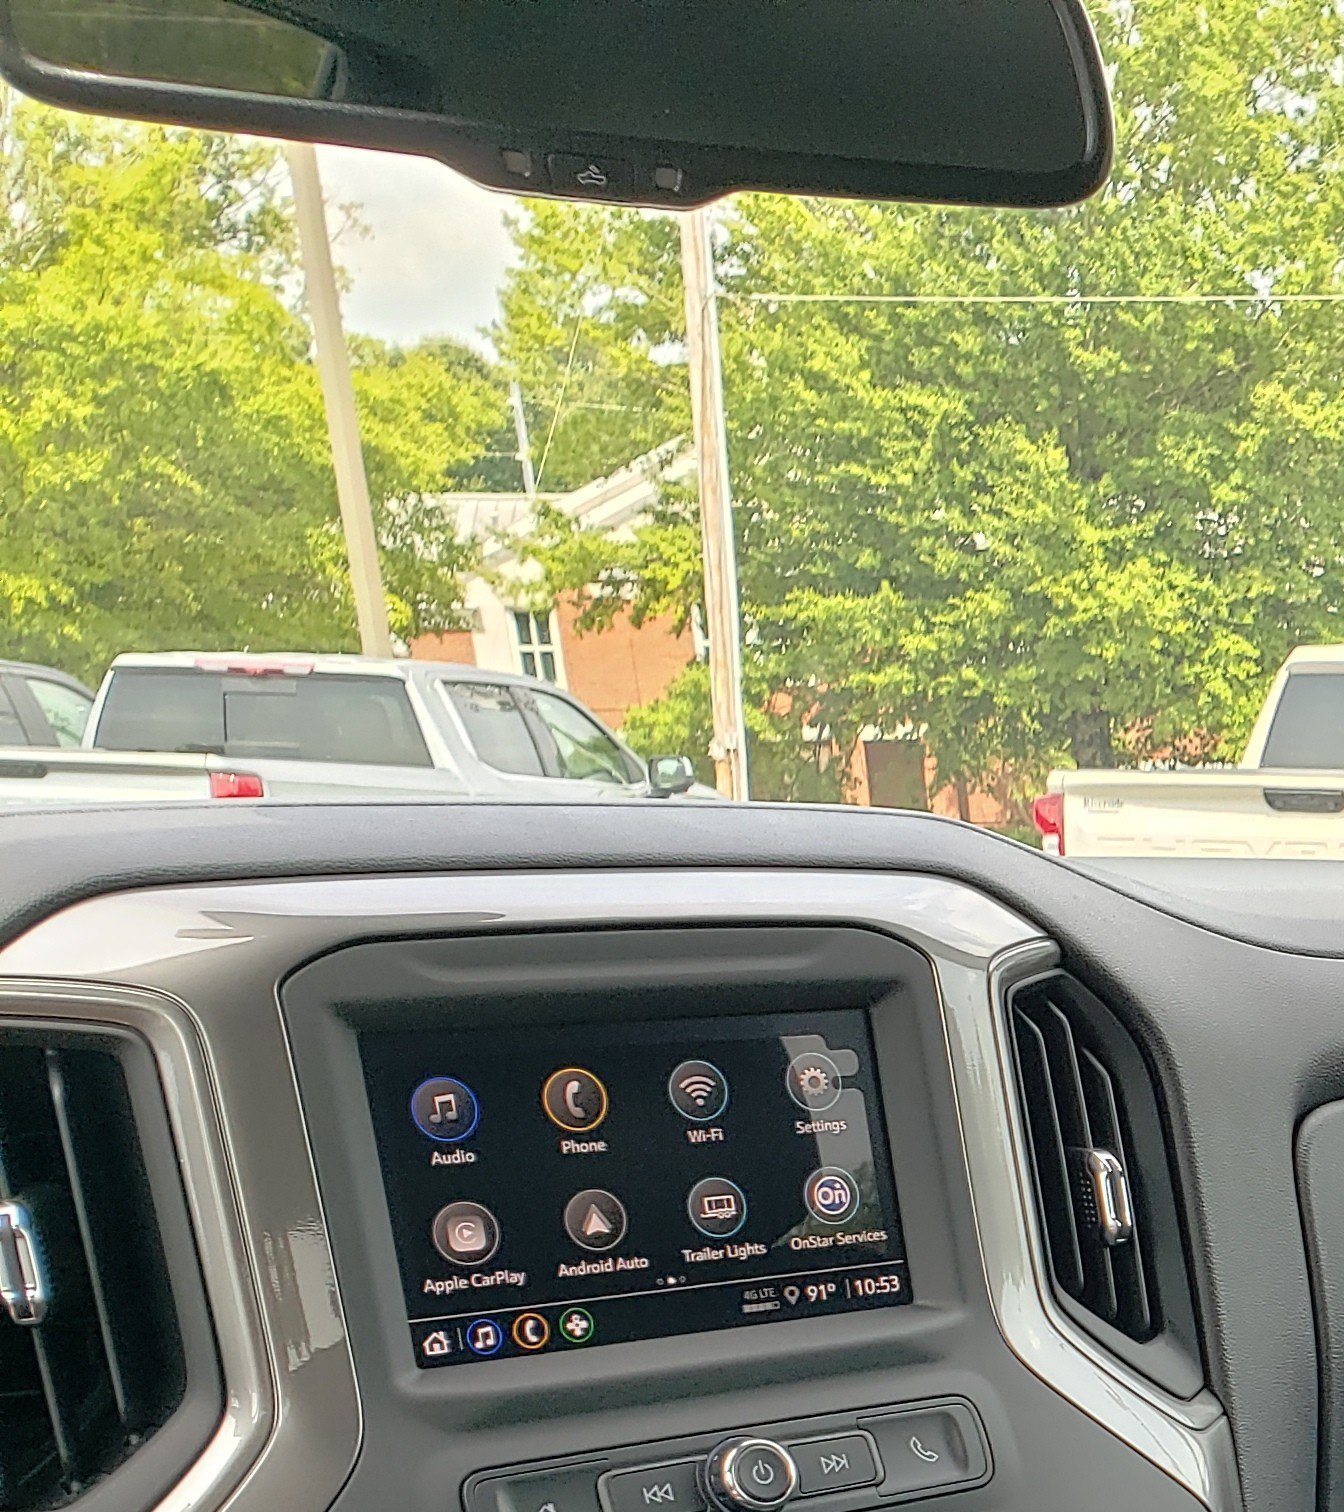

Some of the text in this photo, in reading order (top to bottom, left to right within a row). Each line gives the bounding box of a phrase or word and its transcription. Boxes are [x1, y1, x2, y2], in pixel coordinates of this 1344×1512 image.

[687, 1128, 724, 1144] Wi-Fi
[795, 1119, 847, 1135] Settings
[560, 1139, 607, 1154] Phone
[431, 1149, 476, 1166] Audio
[790, 1229, 888, 1251] OnStar Services
[681, 1242, 768, 1263] Trailer Lights
[558, 1255, 650, 1277] Android Auto
[423, 1269, 526, 1295] Apple CarPlay
[854, 1275, 900, 1297] 10:53
[743, 1287, 776, 1300] 4G LTE
